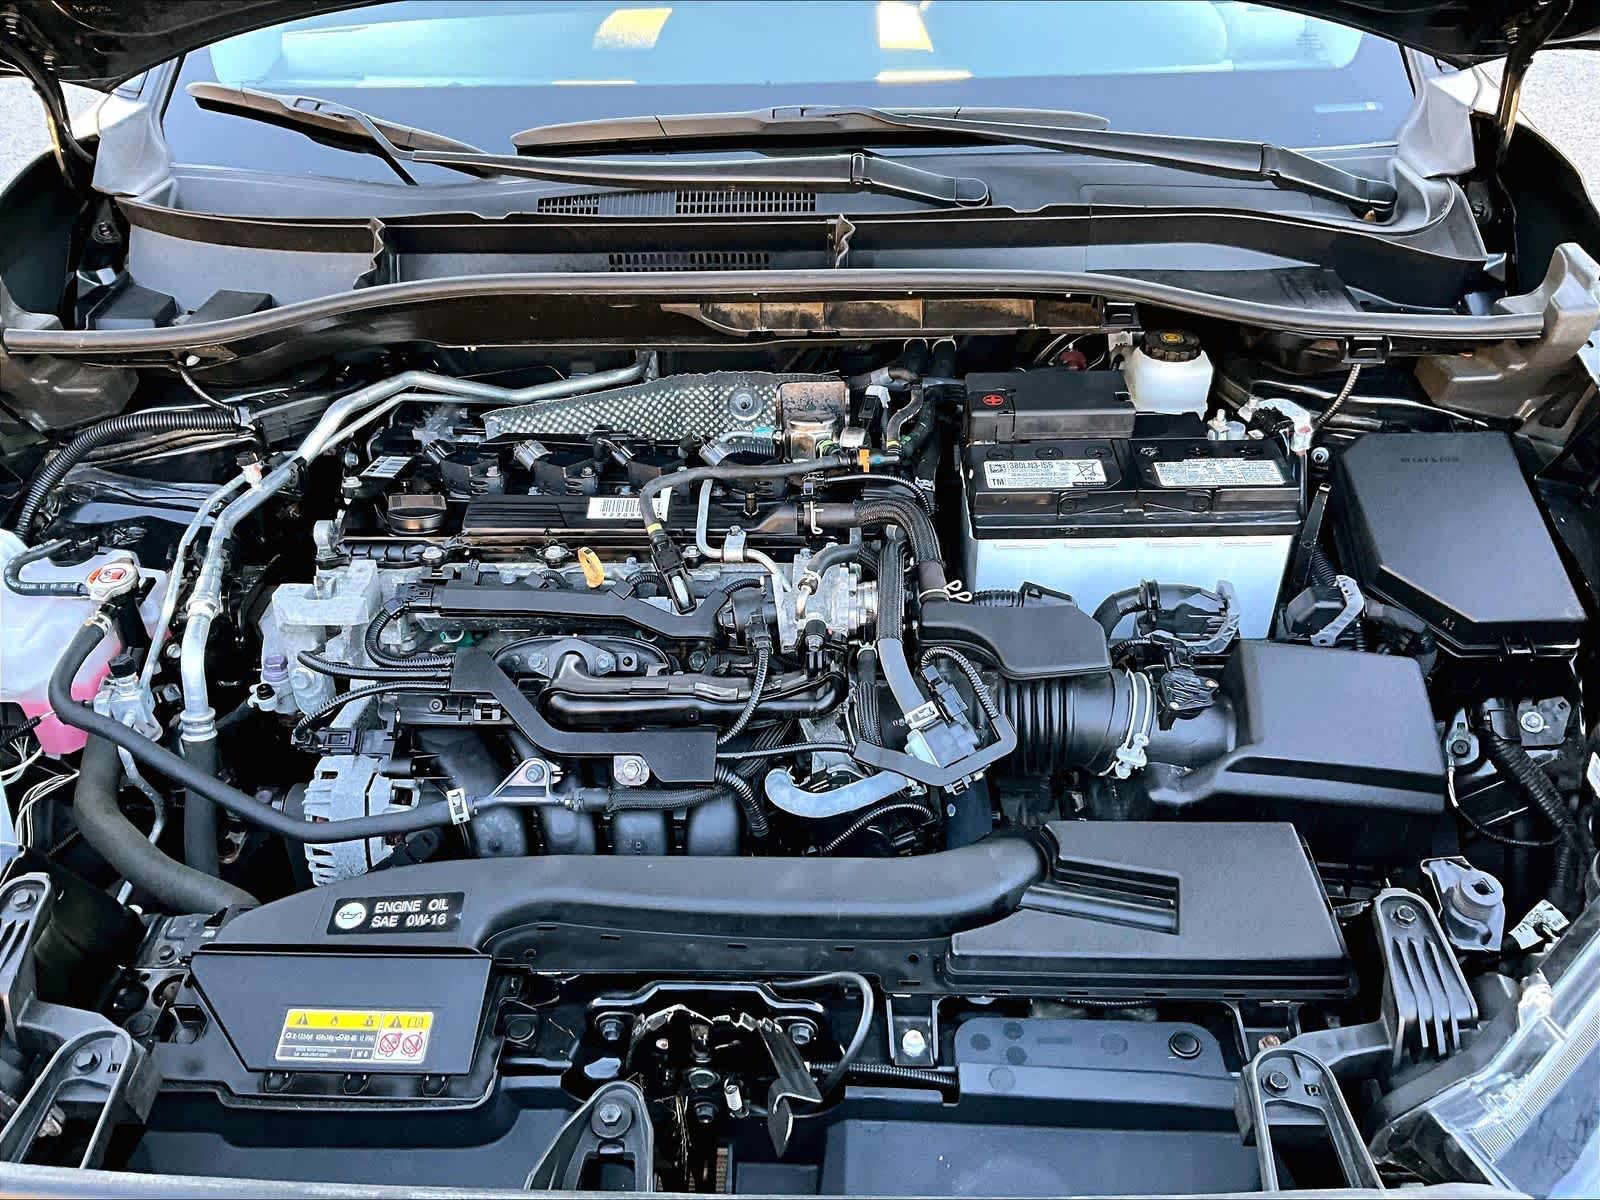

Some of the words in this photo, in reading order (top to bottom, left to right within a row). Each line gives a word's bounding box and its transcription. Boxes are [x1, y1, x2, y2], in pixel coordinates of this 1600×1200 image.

[374, 900, 422, 914] ENGINE
[428, 898, 449, 912] OIL
[370, 914, 399, 928] SAE
[405, 913, 447, 928] 0W-16
